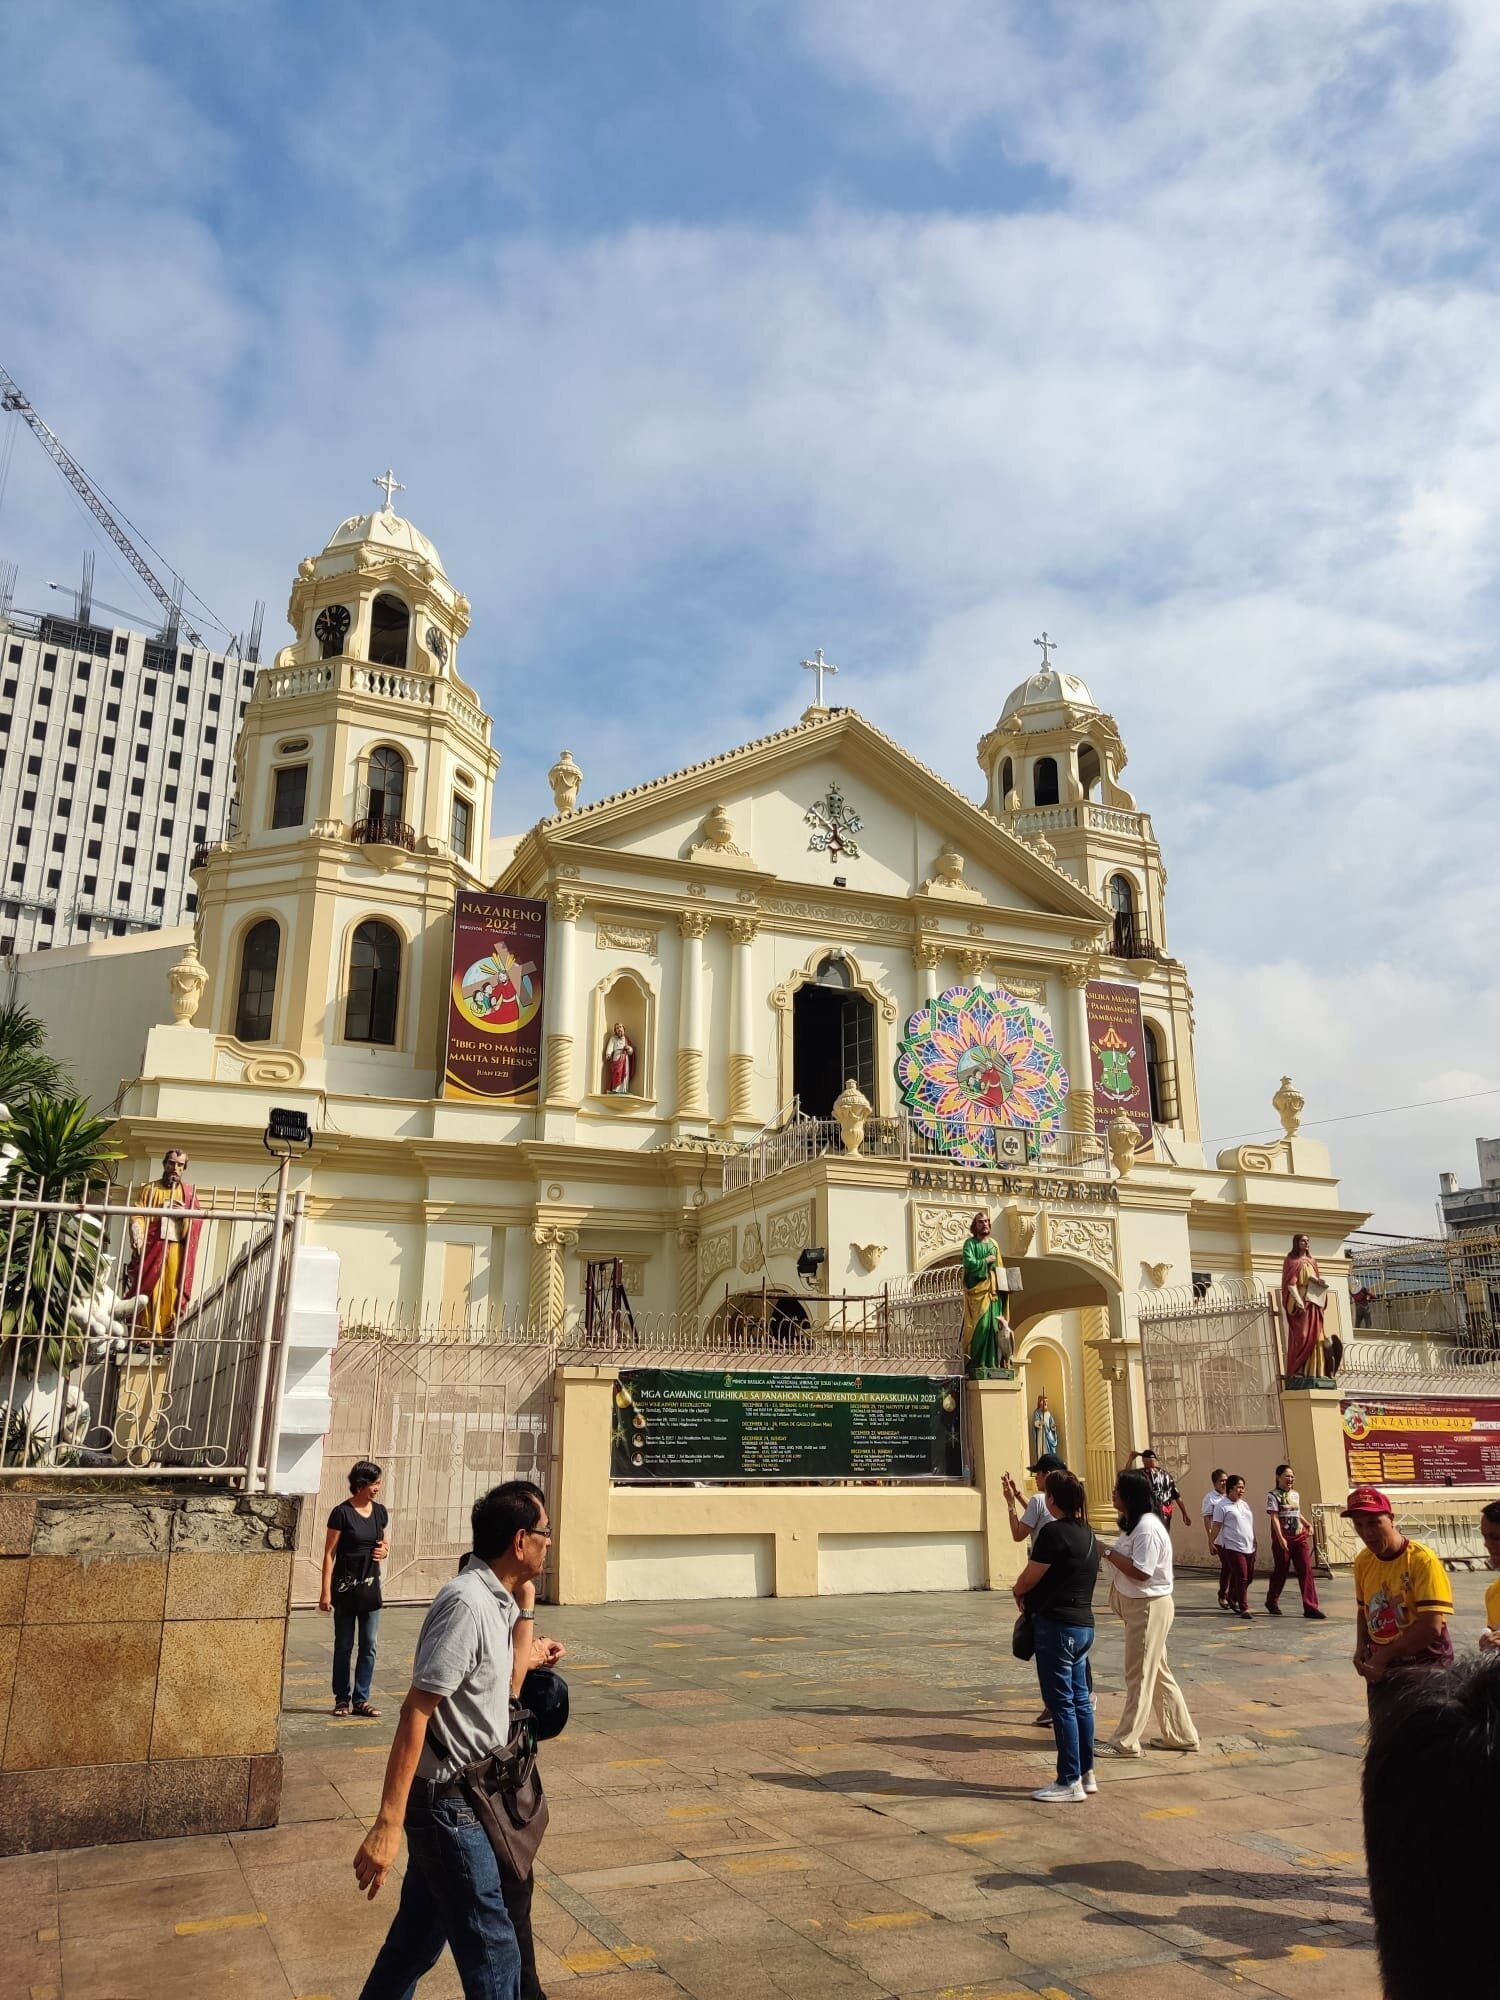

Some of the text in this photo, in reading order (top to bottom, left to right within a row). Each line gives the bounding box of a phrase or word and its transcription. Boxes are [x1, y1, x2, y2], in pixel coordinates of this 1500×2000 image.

[462, 903, 541, 922] NAZARENO
[485, 918, 518, 931] 2024
[1086, 992, 1137, 1005] ASILIKA MENOR
[1091, 1002, 1137, 1015] PAMBANSANG
[1088, 1011, 1124, 1023] DAMBANA
[478, 1042, 493, 1051] PO
[495, 1044, 537, 1055] NAMING
[449, 1053, 488, 1064] MAKITA
[491, 1056, 499, 1064] SI
[1094, 1107, 1109, 1115] ESUS
[1002, 1176, 1024, 1195] NG
[641, 1390, 661, 1399] MGA
[663, 1390, 702, 1399] GAWAING
[704, 1391, 748, 1400] LITURHIKAL
[750, 1392, 760, 1400] SA
[761, 1392, 800, 1400] PANAHON
[802, 1393, 814, 1401] NG
[816, 1393, 857, 1401] ADBIYENTO
[870, 1394, 919, 1402] KAPASKUHAN
[920, 1394, 937, 1403] 2023
[1371, 1418, 1439, 1426] NAZARENO
[1447, 1418, 1473, 1427] 2024
